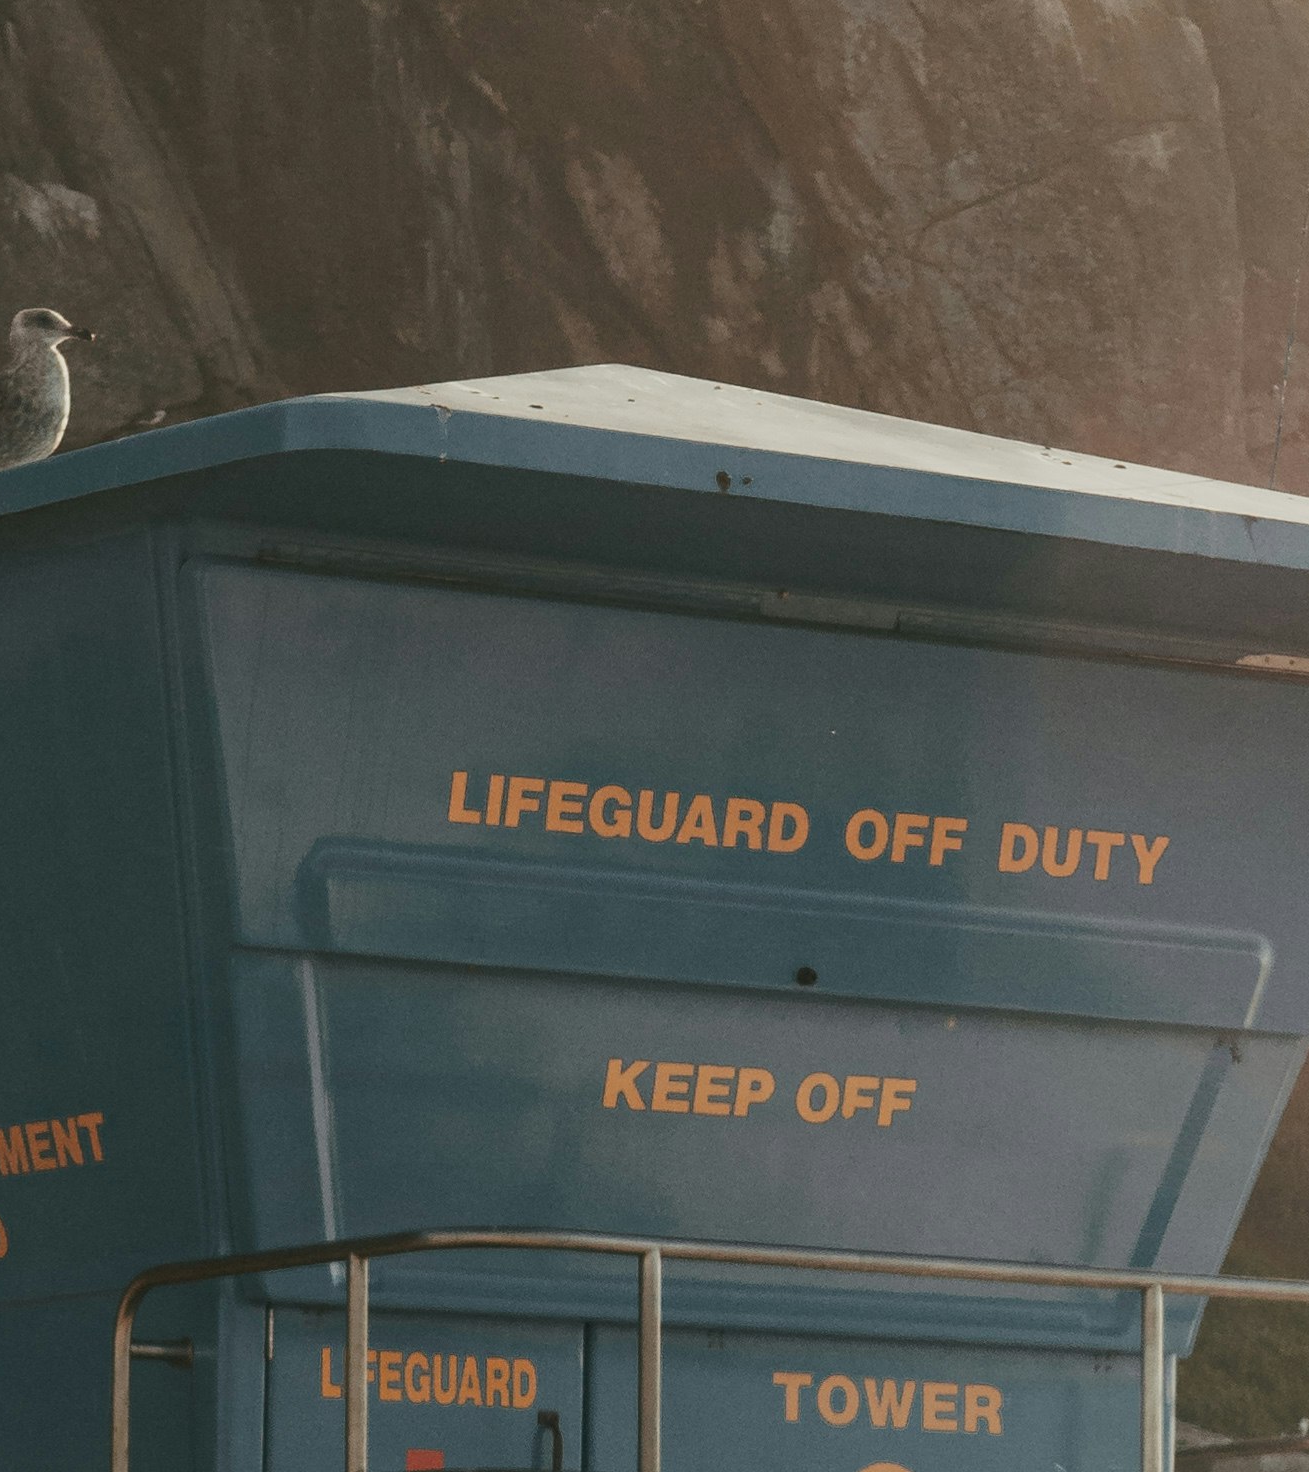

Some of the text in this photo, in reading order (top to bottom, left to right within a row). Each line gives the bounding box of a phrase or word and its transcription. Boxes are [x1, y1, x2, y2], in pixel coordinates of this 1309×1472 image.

[448, 771, 1170, 885] LIFEGUARD OFF DUTY
[602, 1058, 917, 1127] KEEP OFF
[320, 1347, 537, 1410] LFEGUARD
[773, 1371, 1002, 1435] TOWER
